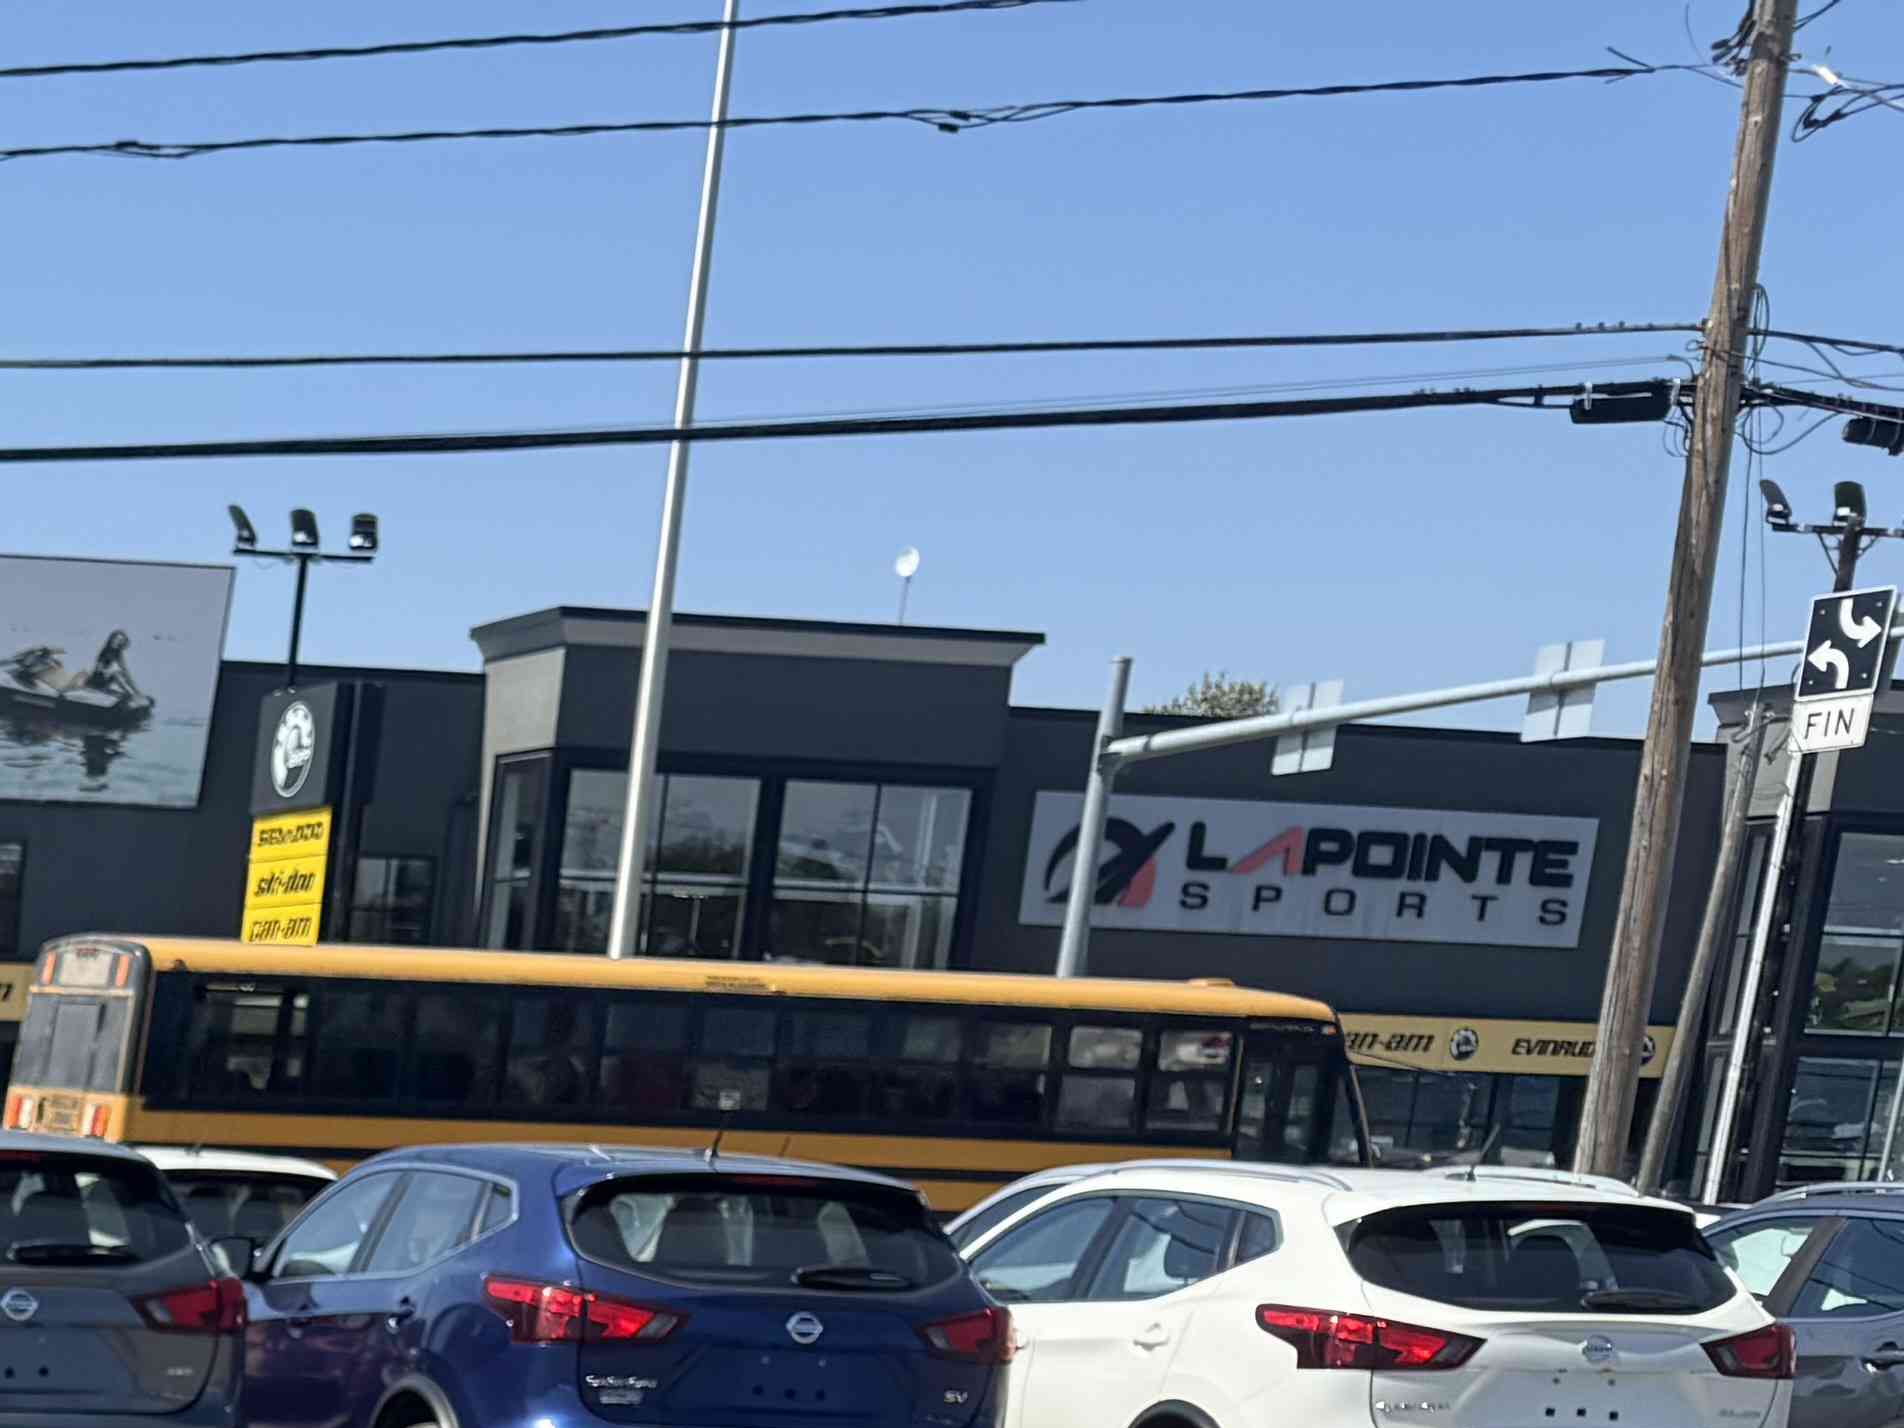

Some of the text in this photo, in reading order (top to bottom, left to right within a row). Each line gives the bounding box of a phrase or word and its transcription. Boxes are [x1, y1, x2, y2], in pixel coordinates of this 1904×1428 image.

[1804, 708, 1855, 739] FIN
[1185, 821, 1580, 889] LAPOINTE
[1179, 881, 1569, 927] SPORTS
[1345, 1031, 1435, 1053] an-am
[1511, 1038, 1596, 1058] EVINRUD
